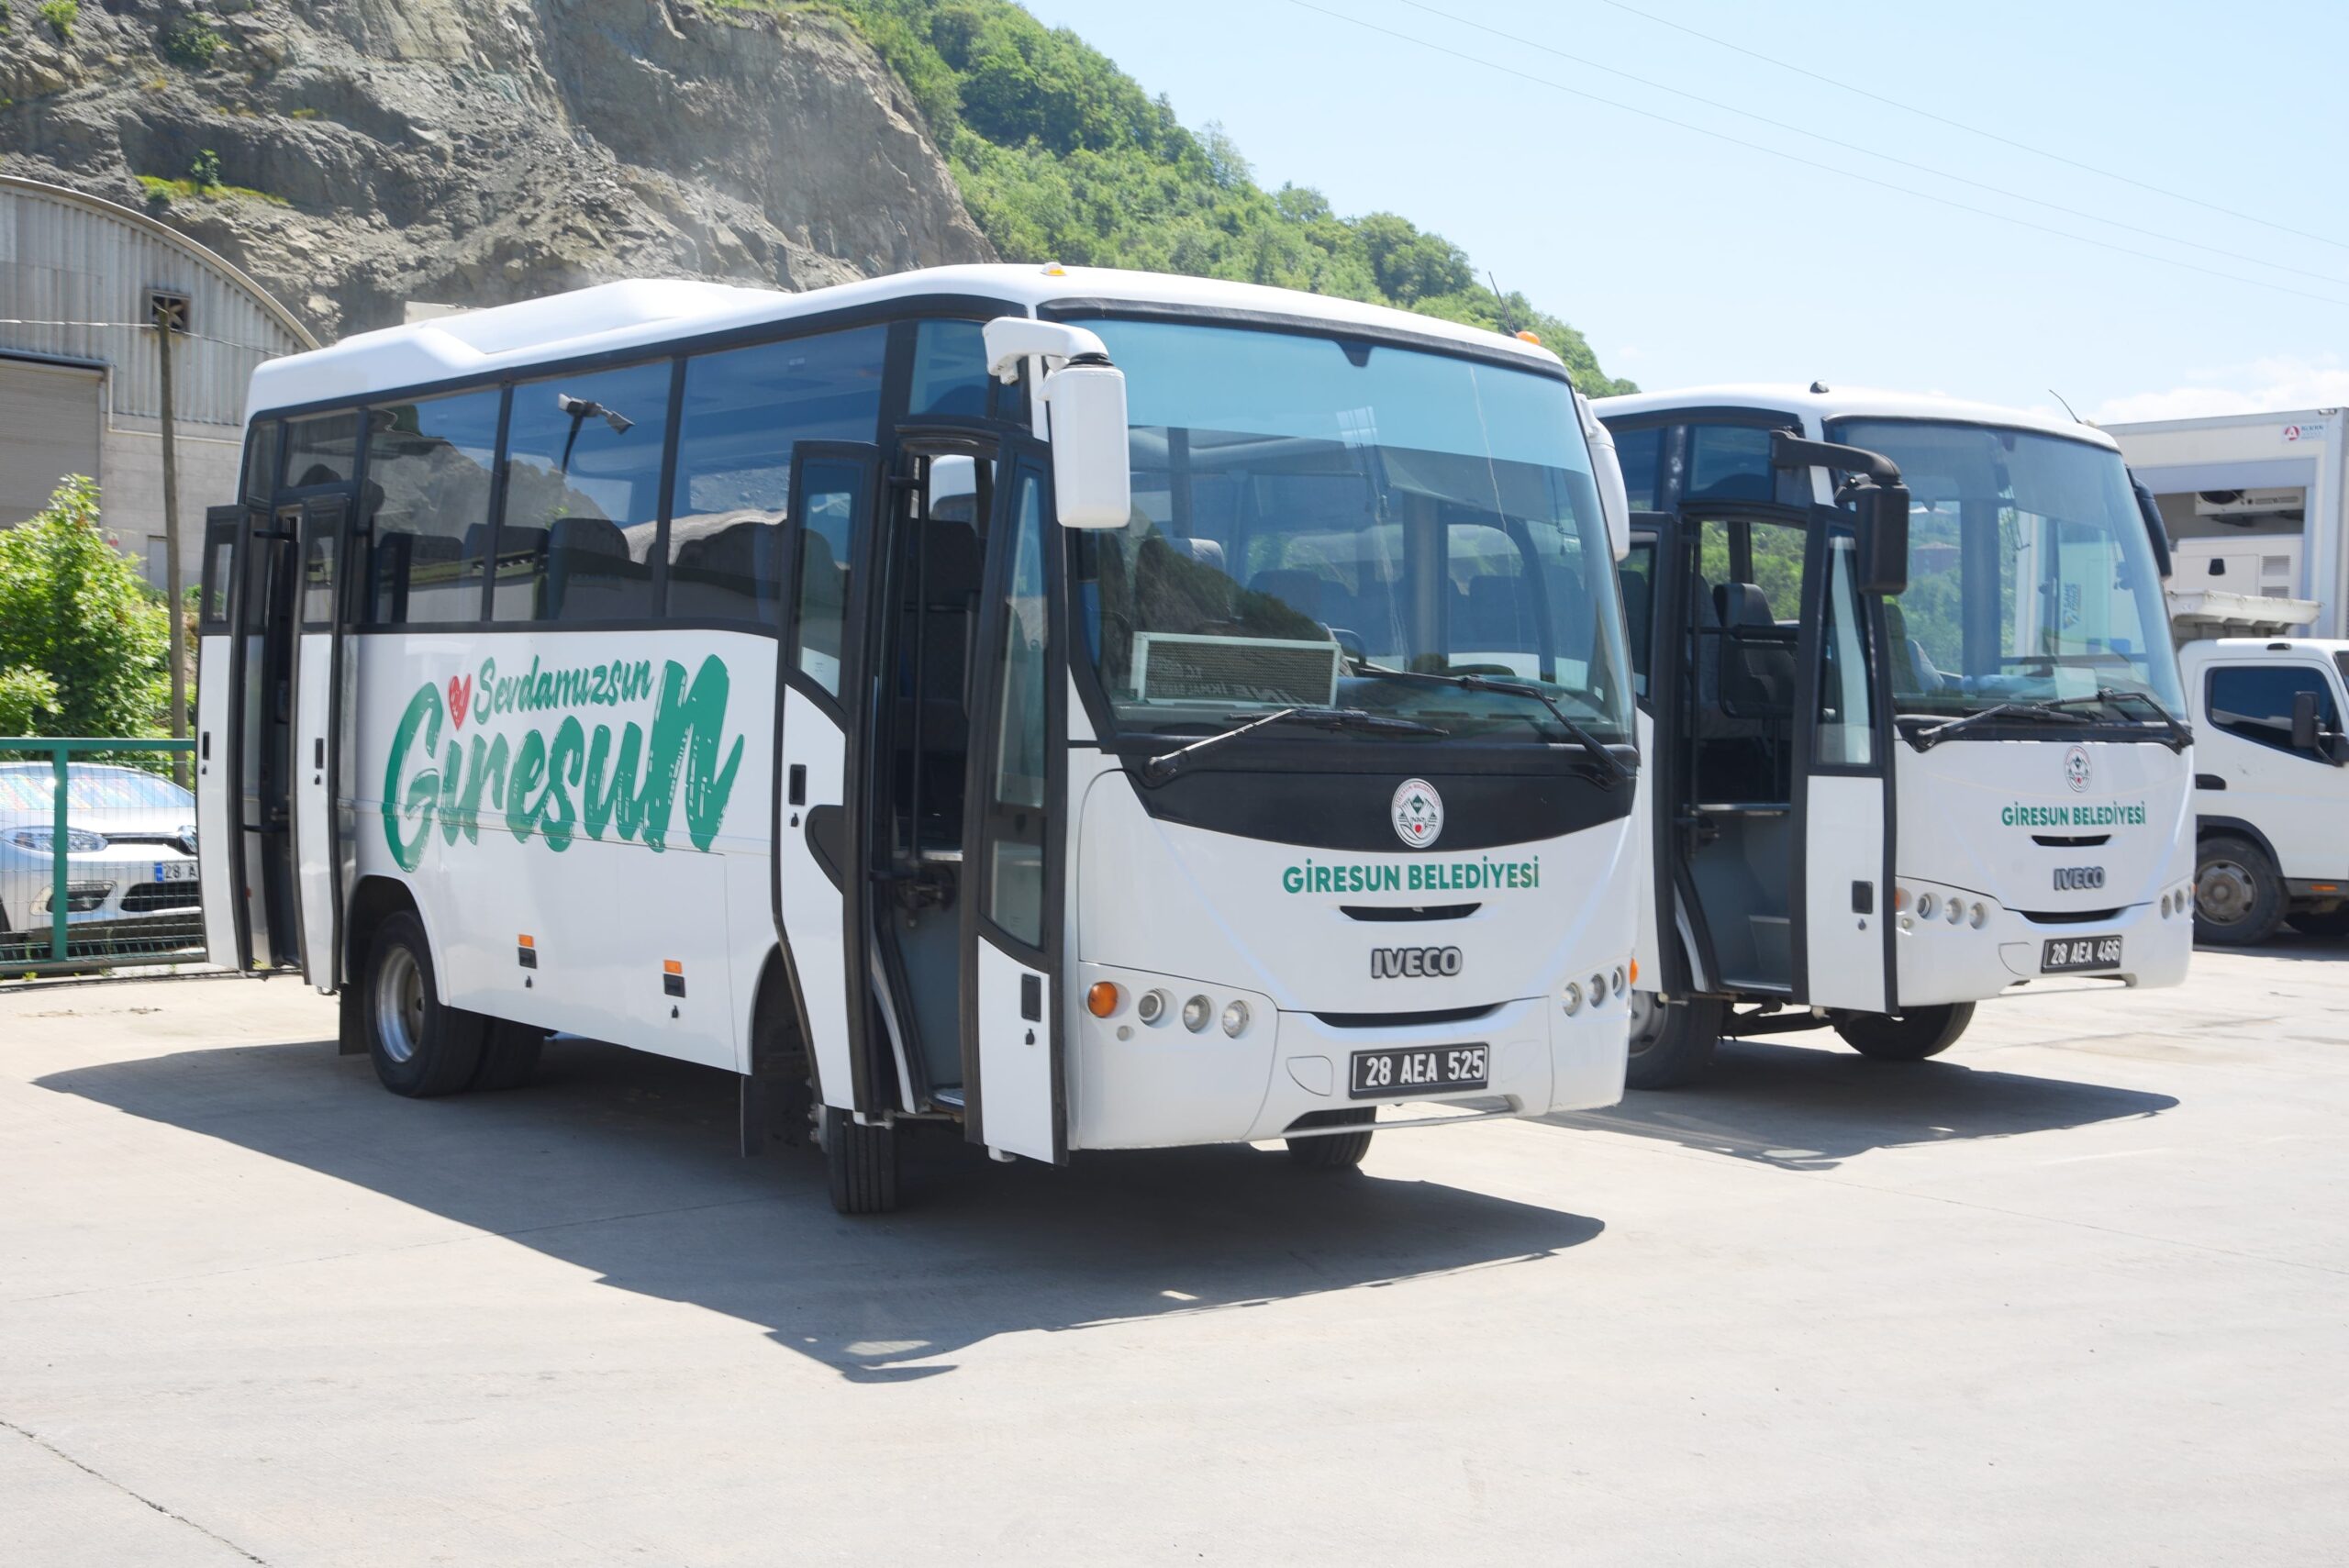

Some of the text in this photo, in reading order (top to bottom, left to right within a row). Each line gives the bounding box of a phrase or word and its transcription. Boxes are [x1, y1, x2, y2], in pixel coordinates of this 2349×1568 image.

[2001, 800, 2146, 826] GİRESUN BELEDİYESİ
[1283, 855, 1541, 894] GİRESUN BELEDİYESİ
[2054, 866, 2105, 890] IVECO
[1371, 946, 1463, 979] IVECO
[2050, 943, 2068, 965] 28
[2070, 941, 2093, 964] AEA
[1365, 1049, 1486, 1086] 28 AEA 525
